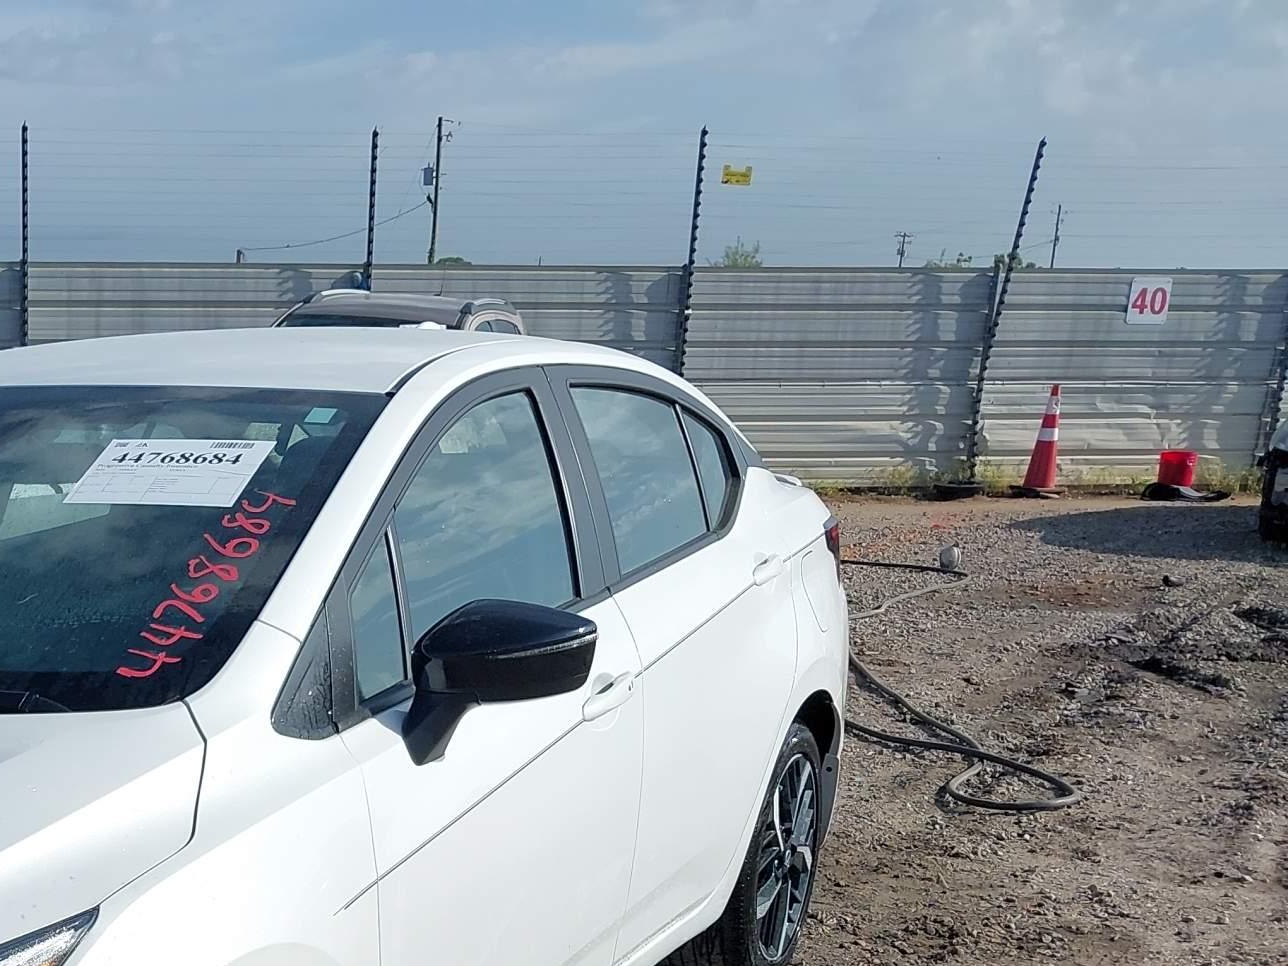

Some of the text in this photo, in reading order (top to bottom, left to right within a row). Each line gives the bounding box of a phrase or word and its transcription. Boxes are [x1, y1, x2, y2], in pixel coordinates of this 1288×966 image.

[1131, 287, 1167, 315] 40
[112, 451, 243, 465] 44768684
[115, 488, 297, 678] 44768684
